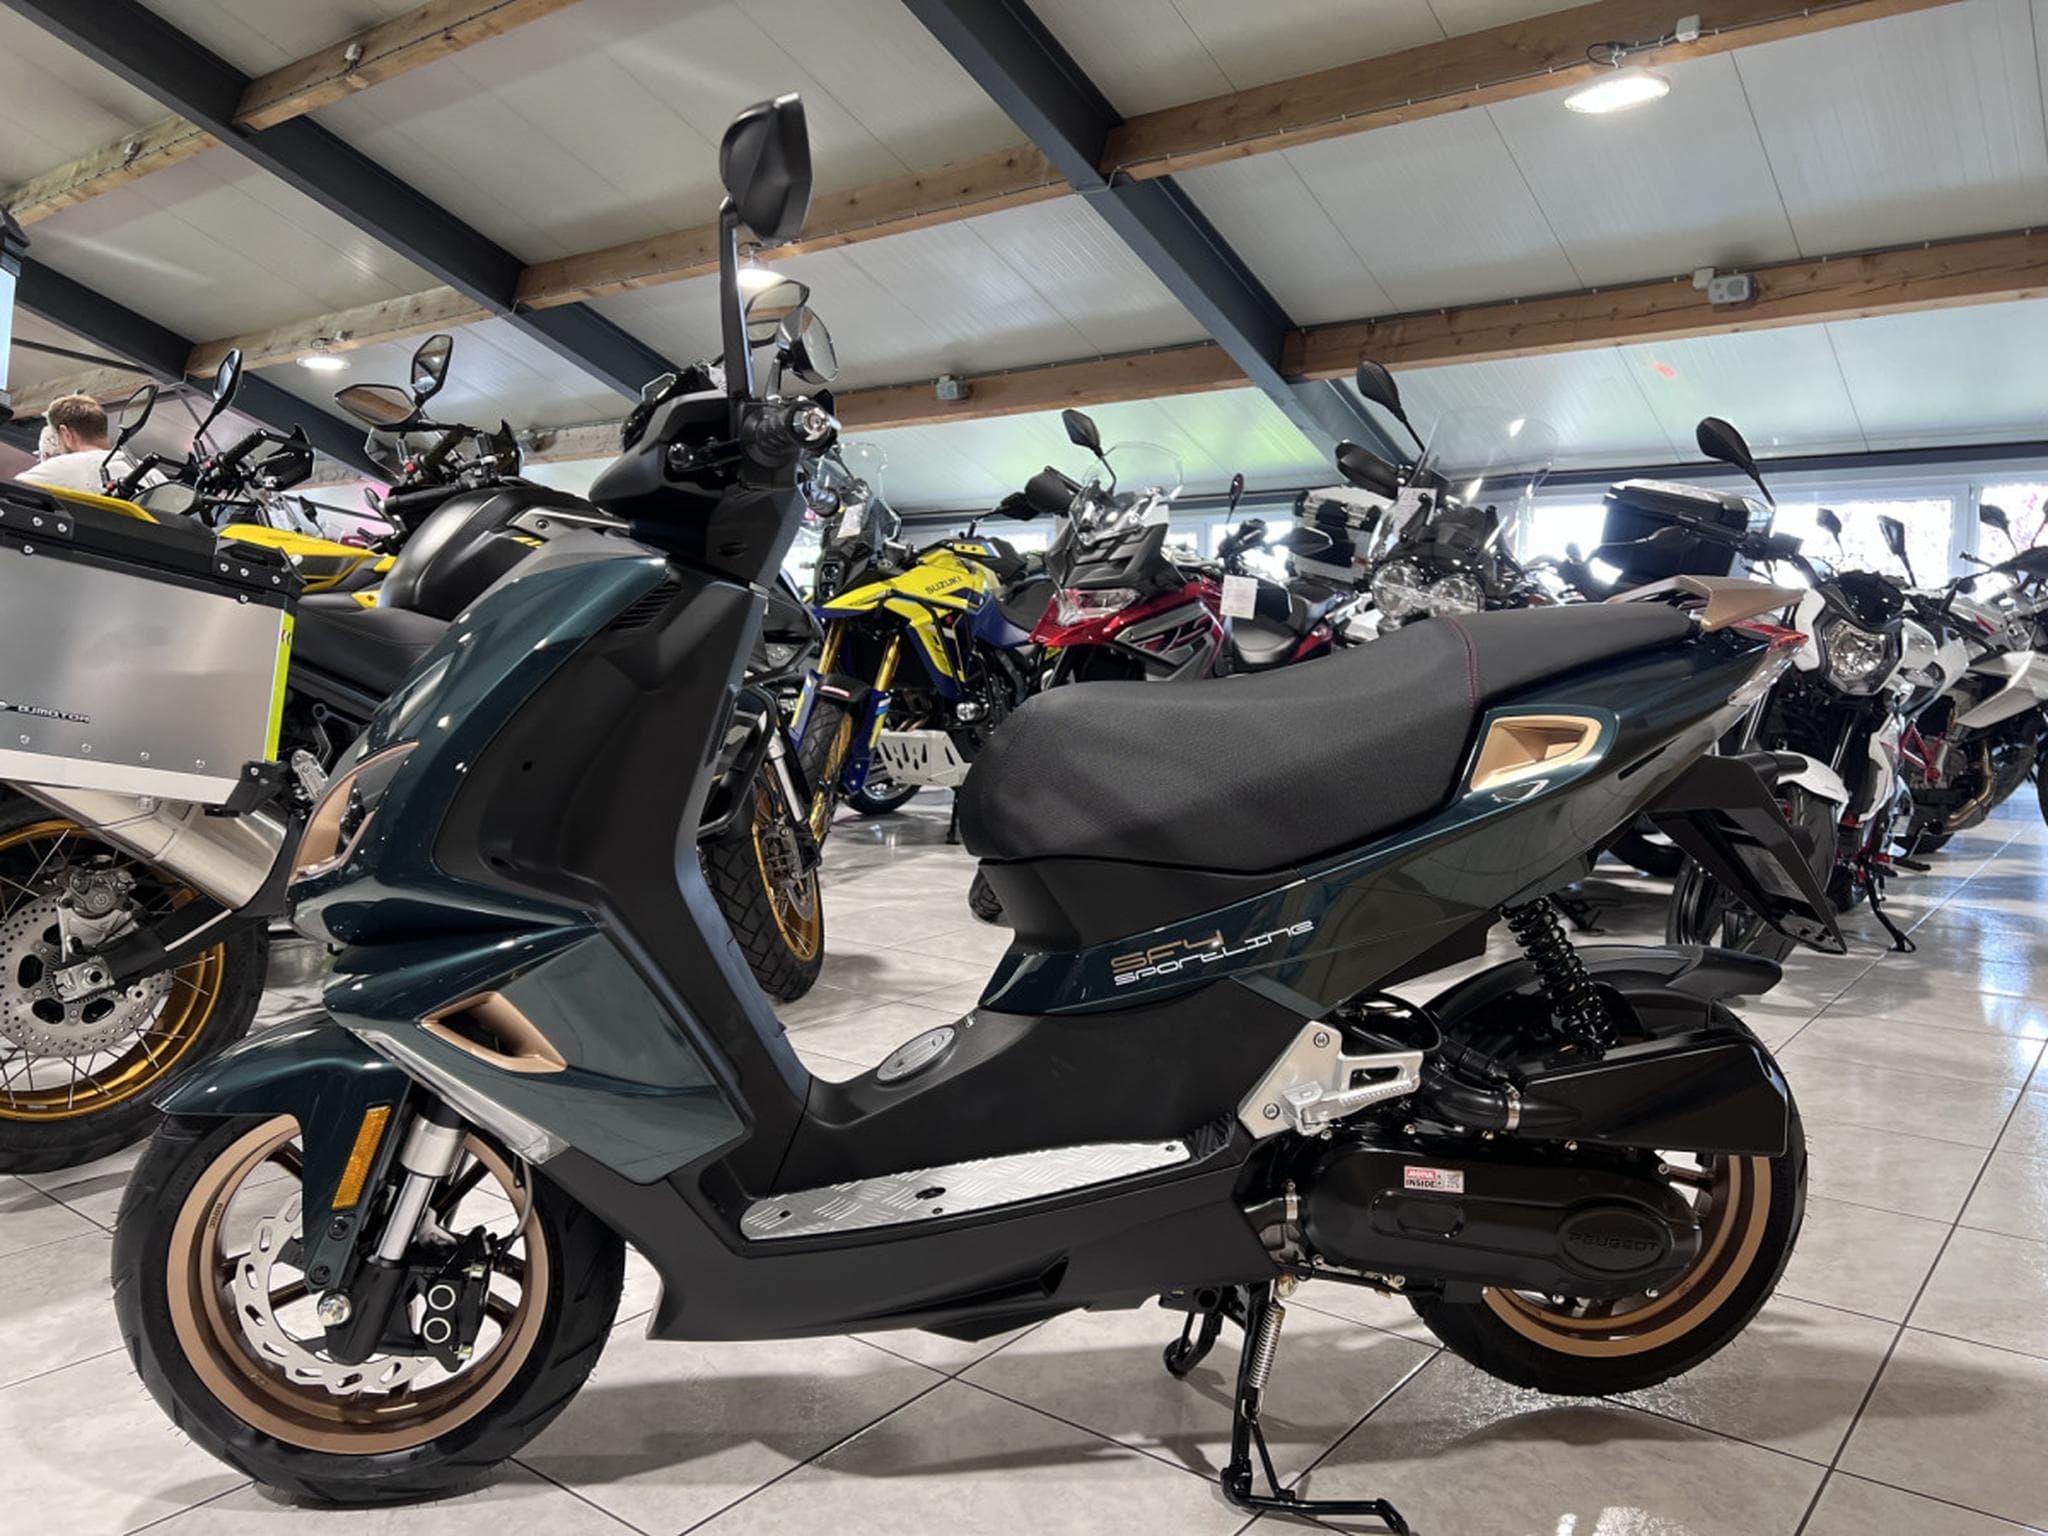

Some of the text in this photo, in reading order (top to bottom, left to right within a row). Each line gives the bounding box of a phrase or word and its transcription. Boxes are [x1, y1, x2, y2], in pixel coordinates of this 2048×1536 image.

[925, 576, 962, 593] SUZUKI
[1110, 929, 1225, 974] SF4
[1406, 1179, 1435, 1188] INSIDE
[1568, 1231, 1658, 1252] PEUGEOT
